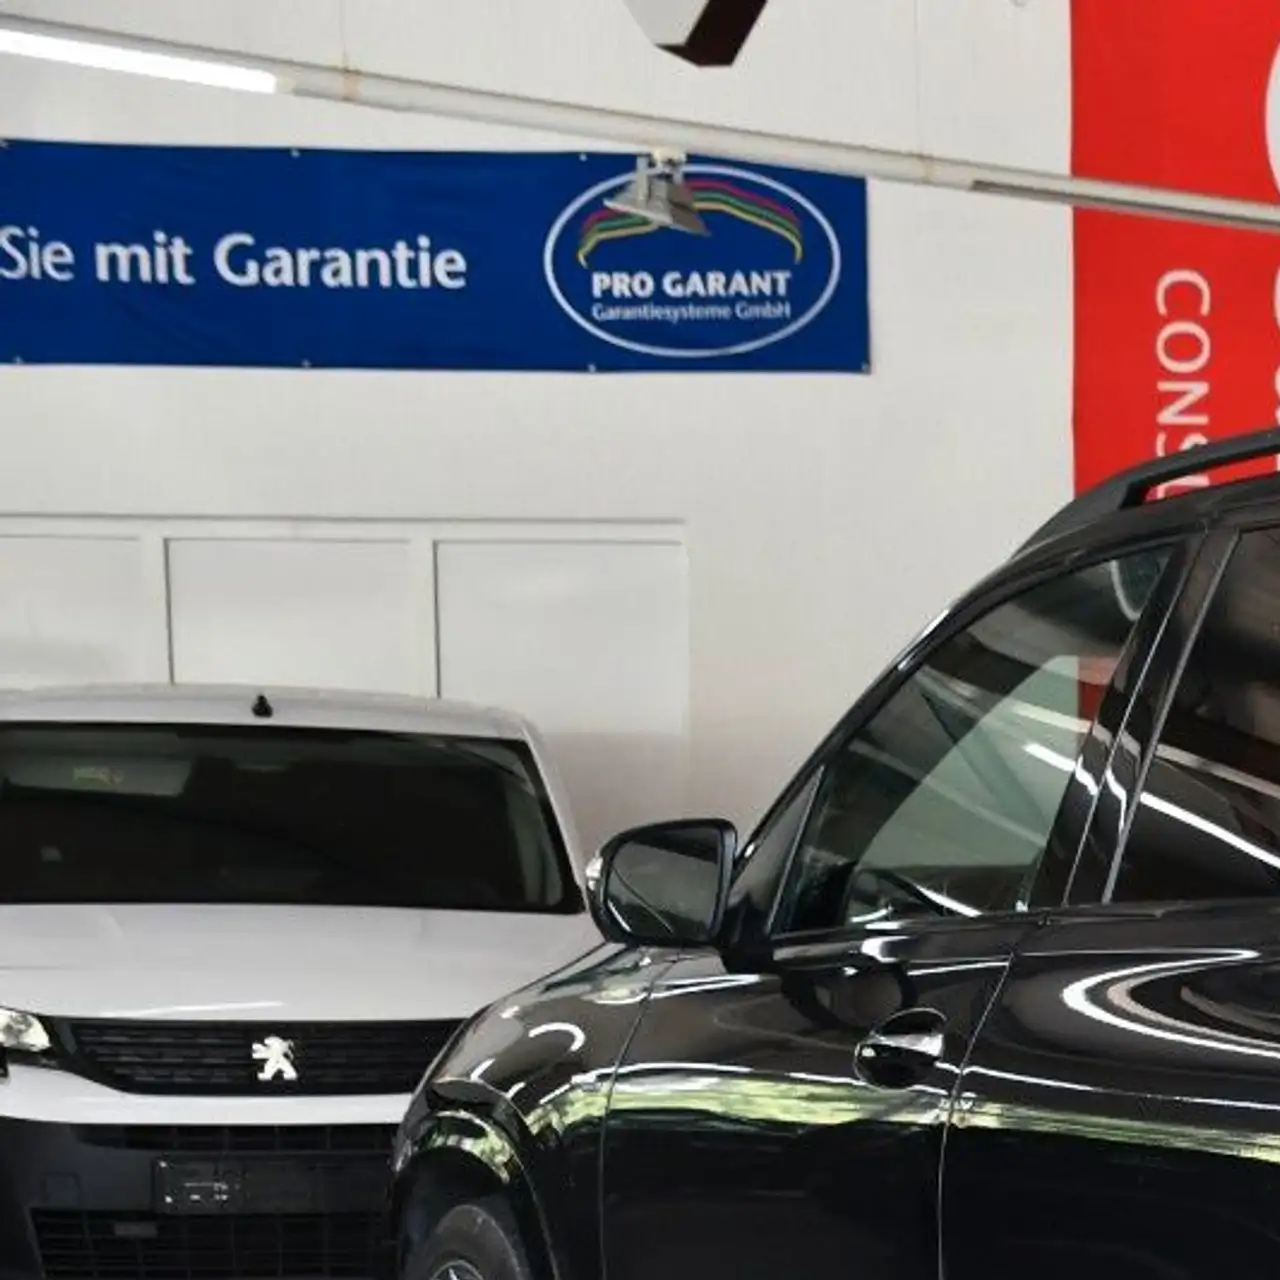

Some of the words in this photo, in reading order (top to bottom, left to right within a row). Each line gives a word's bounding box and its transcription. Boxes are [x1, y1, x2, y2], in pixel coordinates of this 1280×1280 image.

[0, 225, 75, 282] Sie
[93, 229, 197, 285] mit
[213, 232, 468, 289] Garantie
[592, 270, 656, 299] PRO
[661, 269, 792, 298] GARANT
[592, 301, 732, 324] Garantiesysteme
[734, 300, 792, 320] GmbH
